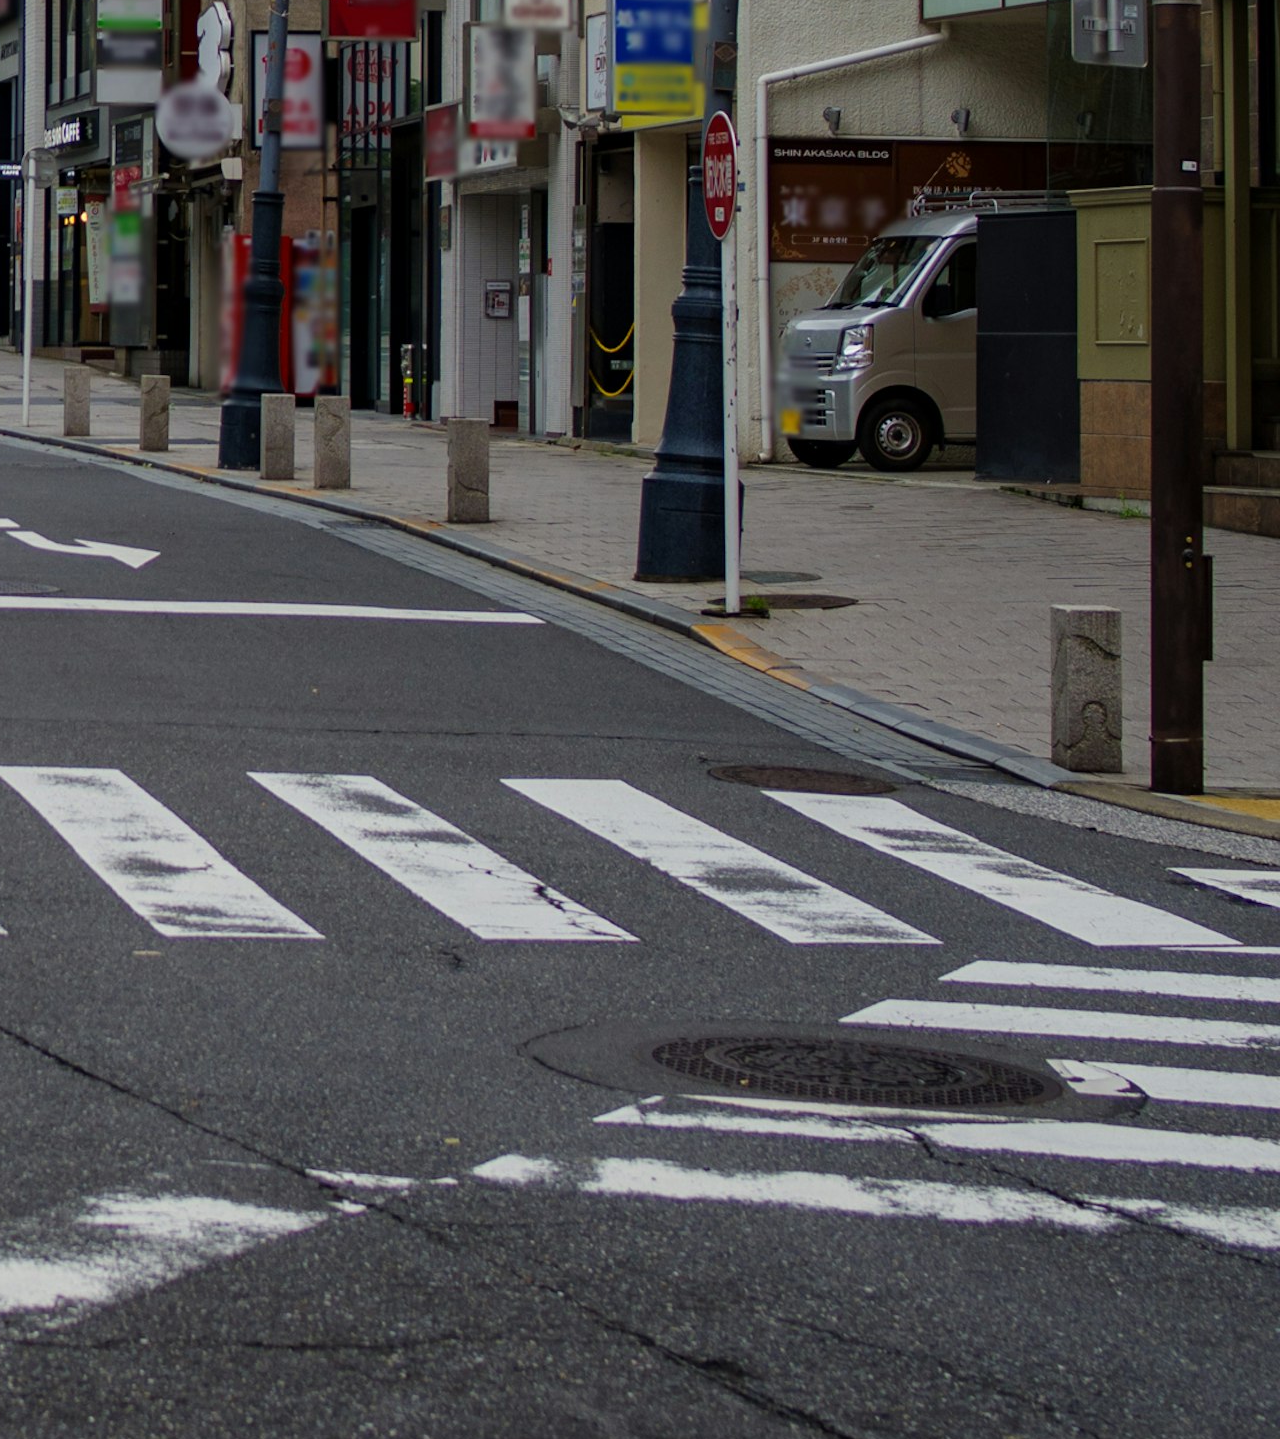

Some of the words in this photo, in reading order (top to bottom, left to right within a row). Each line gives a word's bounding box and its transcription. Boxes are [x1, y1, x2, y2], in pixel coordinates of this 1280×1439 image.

[774, 148, 801, 157] SHIN
[803, 149, 856, 158] AKASAKA
[857, 150, 889, 159] BLDG
